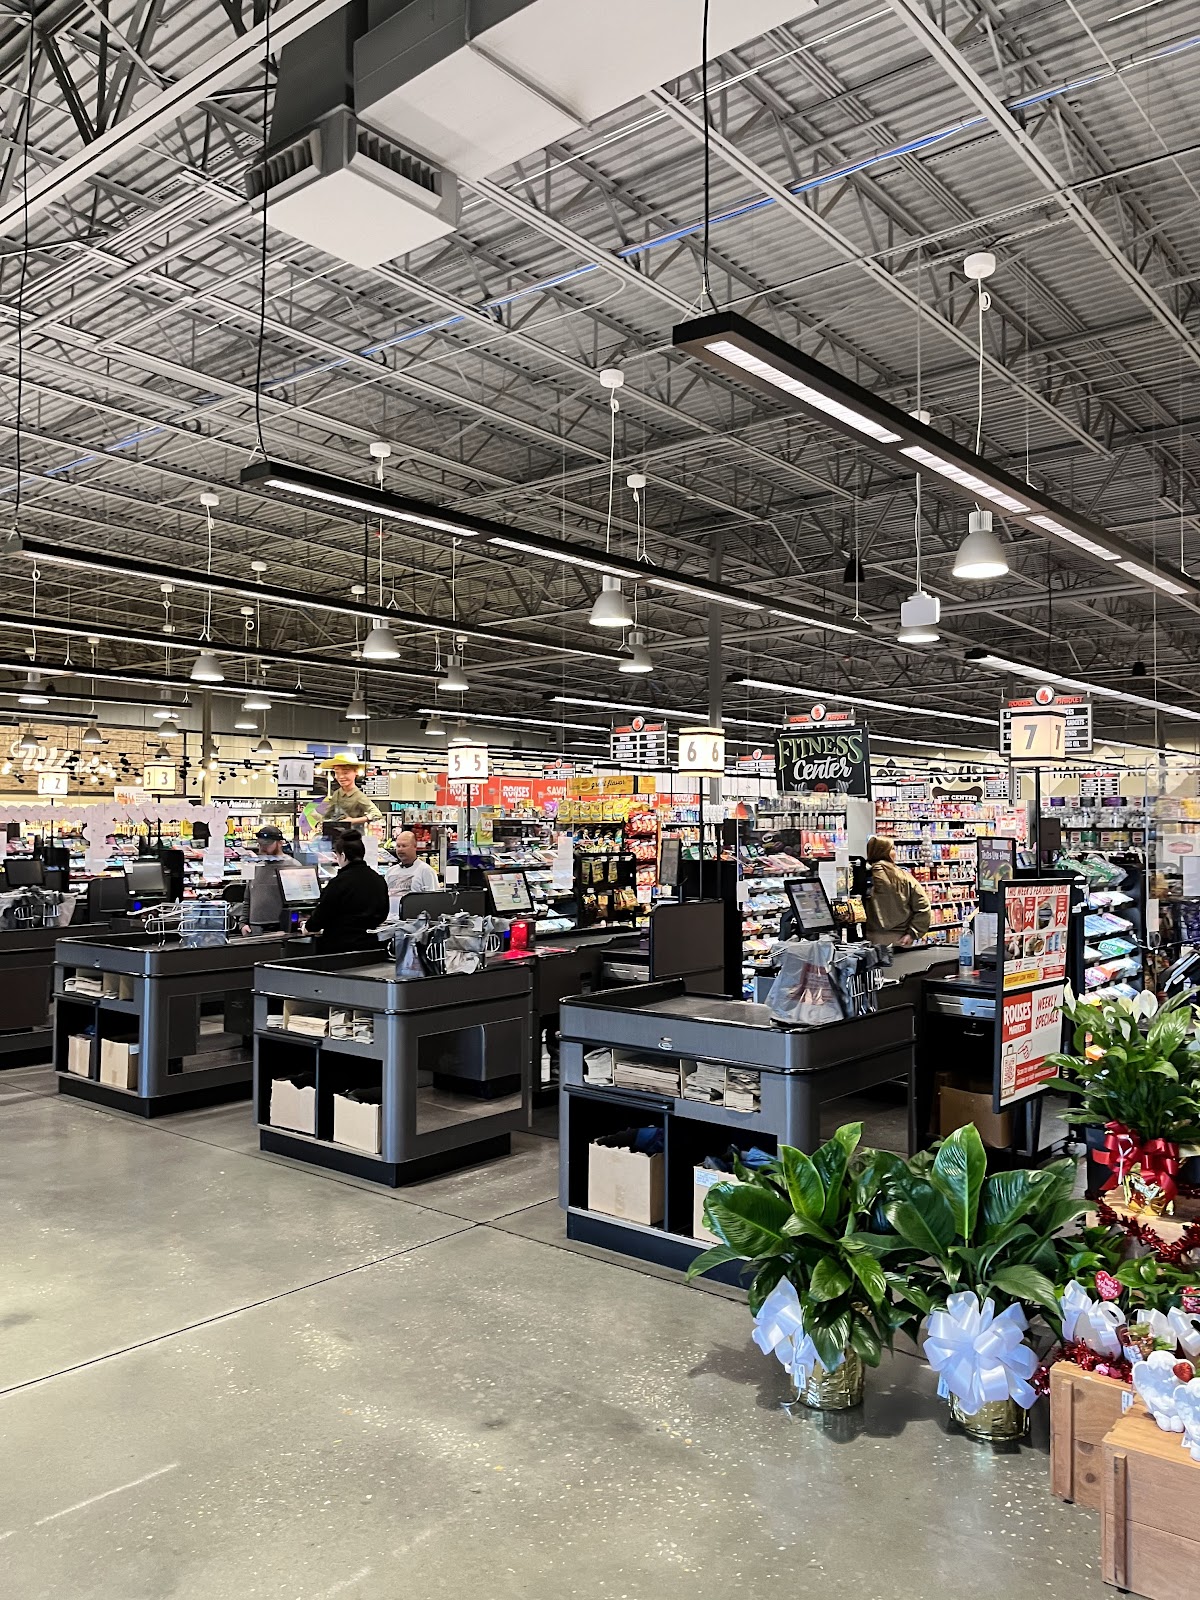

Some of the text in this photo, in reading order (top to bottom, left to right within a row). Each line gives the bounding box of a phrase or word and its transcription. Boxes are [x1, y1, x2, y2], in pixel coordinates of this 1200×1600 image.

[1040, 690, 1049, 703] 4
[1023, 724, 1038, 750] 7
[688, 741, 719, 762] 6 6
[777, 734, 863, 771] FITNESS
[454, 755, 481, 771] 5 5
[793, 756, 853, 781] Center
[56, 778, 61, 789] 2
[162, 772, 168, 785] 3
[503, 786, 530, 797] ROUSES
[951, 794, 978, 802] CENTER
[1037, 994, 1058, 1011] WEEKLY
[1003, 1001, 1031, 1027] ROUSES
[1035, 1010, 1060, 1030] SPECIALS
